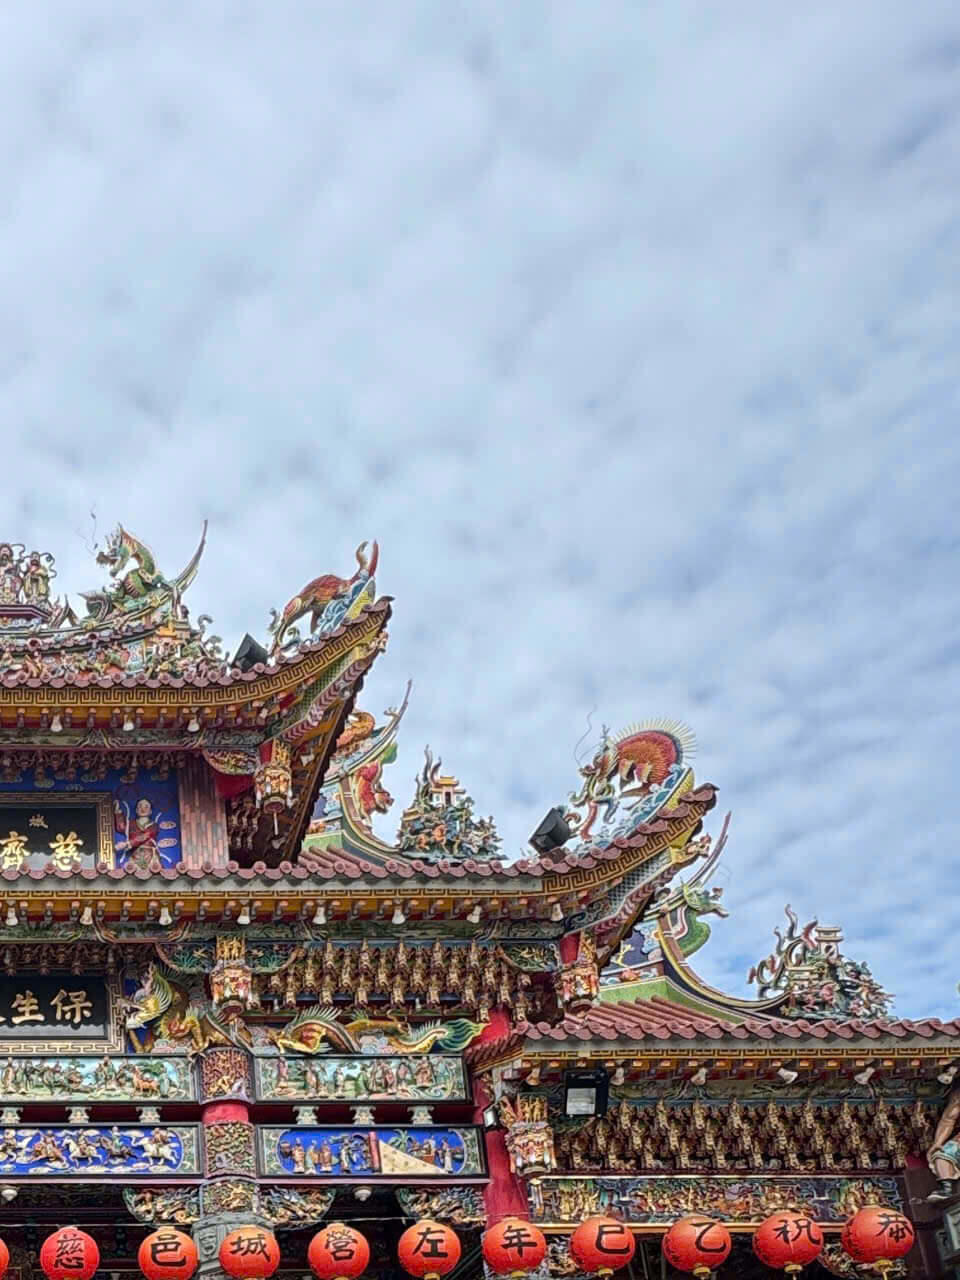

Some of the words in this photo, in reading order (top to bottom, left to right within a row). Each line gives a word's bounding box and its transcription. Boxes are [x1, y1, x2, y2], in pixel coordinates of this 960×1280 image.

[323, 1227, 359, 1261] 營
[412, 1227, 447, 1258] 左
[501, 1225, 538, 1255] 年
[690, 1221, 728, 1253] 乙
[775, 1212, 822, 1244] 祝
[876, 1213, 914, 1243] 恭
[55, 1233, 86, 1269] 慈
[151, 1233, 187, 1266] 邑
[230, 1232, 271, 1260] 城
